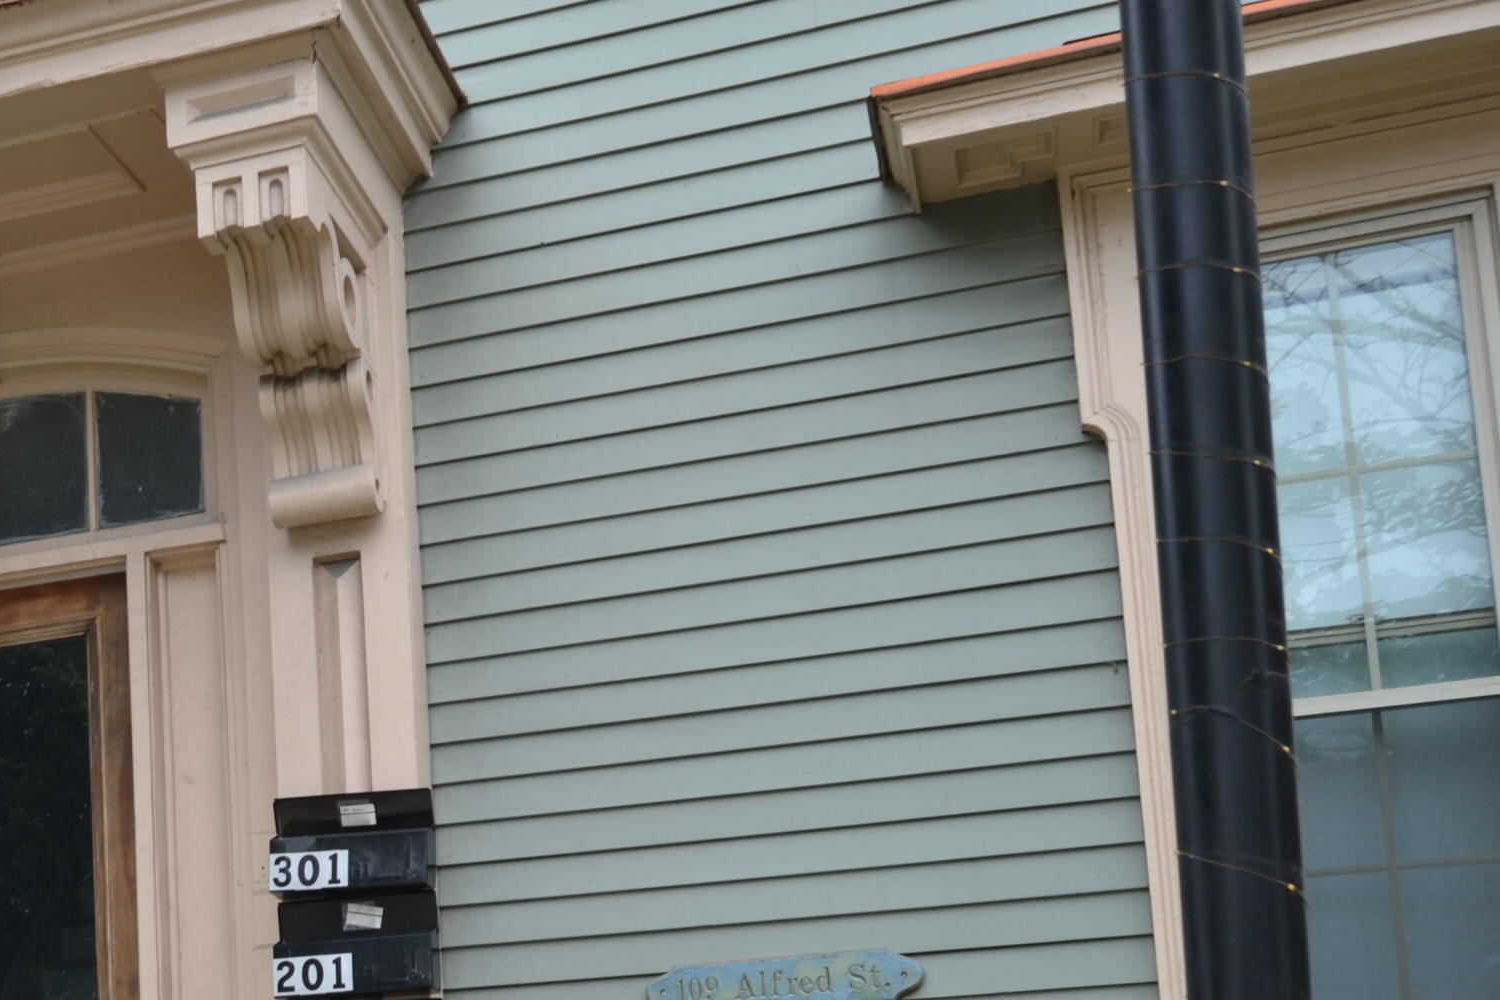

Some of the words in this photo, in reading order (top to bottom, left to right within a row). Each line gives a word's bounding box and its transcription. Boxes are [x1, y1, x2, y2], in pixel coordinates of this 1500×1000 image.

[272, 852, 342, 888] 301
[276, 956, 346, 993] 201
[735, 966, 832, 998] Alfred
[849, 963, 892, 992] St.
